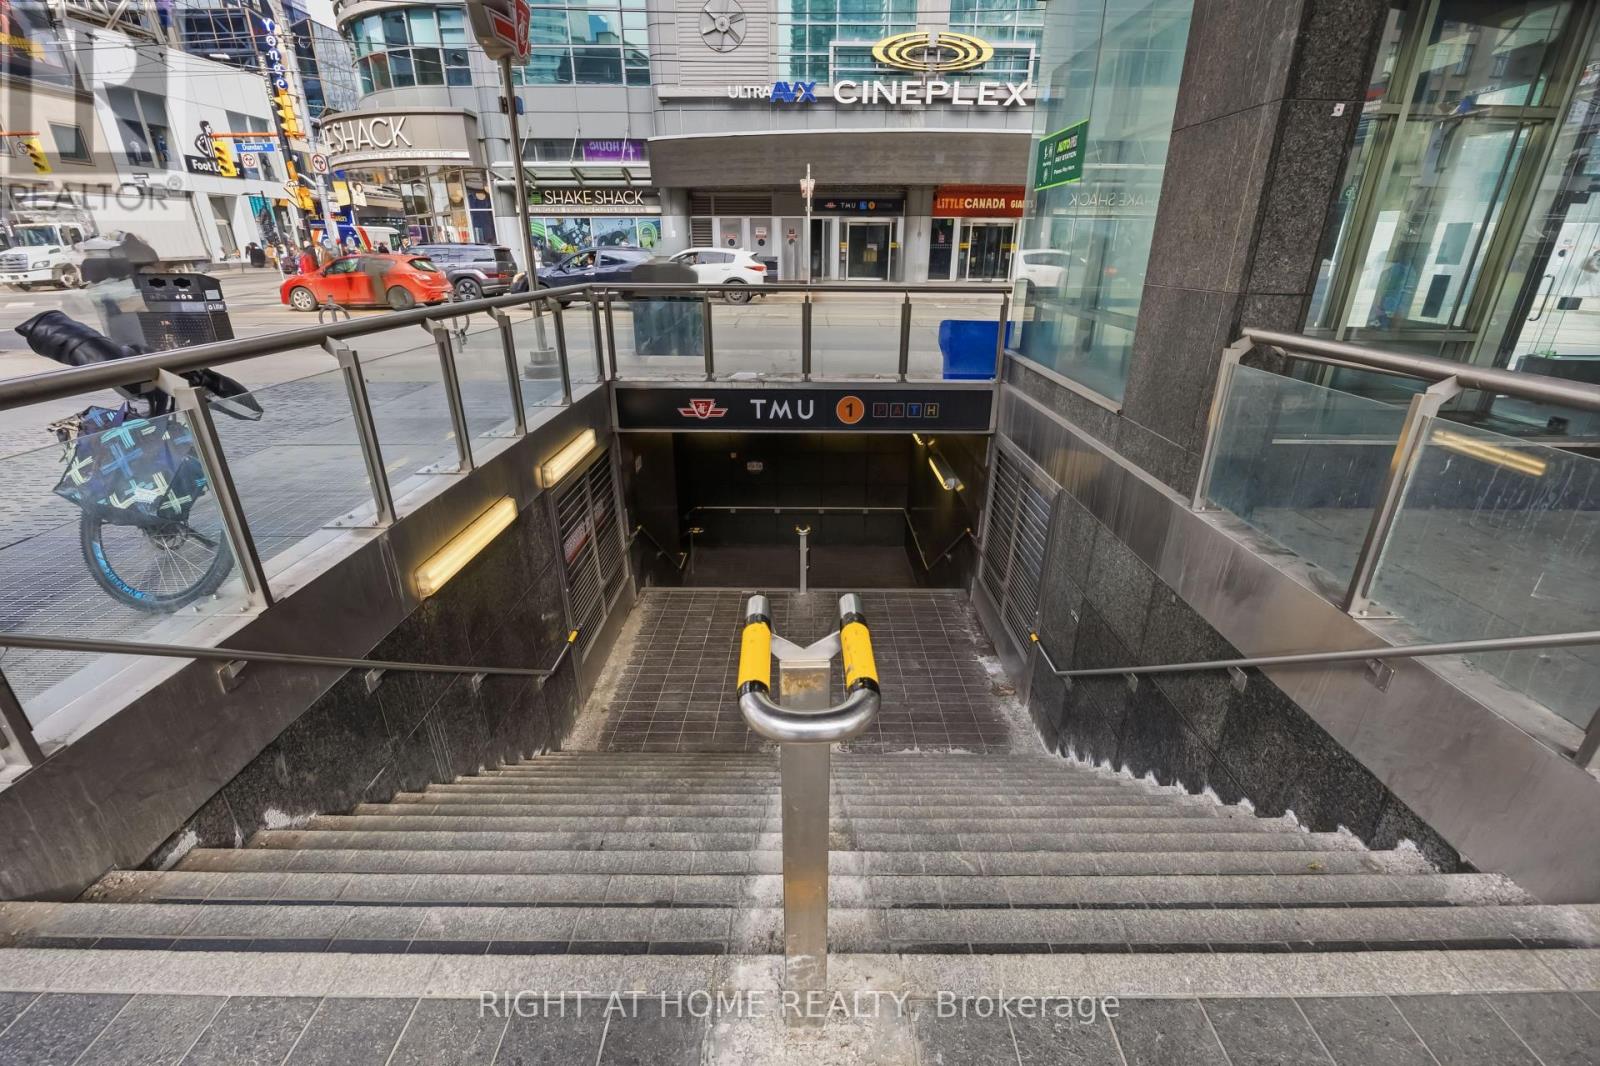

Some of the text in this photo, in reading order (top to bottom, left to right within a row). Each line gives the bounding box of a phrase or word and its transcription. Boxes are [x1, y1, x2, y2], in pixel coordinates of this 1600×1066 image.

[833, 80, 1028, 106] CINEPLEX
[192, 159, 213, 171] Foot
[544, 190, 644, 205] SHAKE SHACK
[750, 399, 814, 420] TMU
